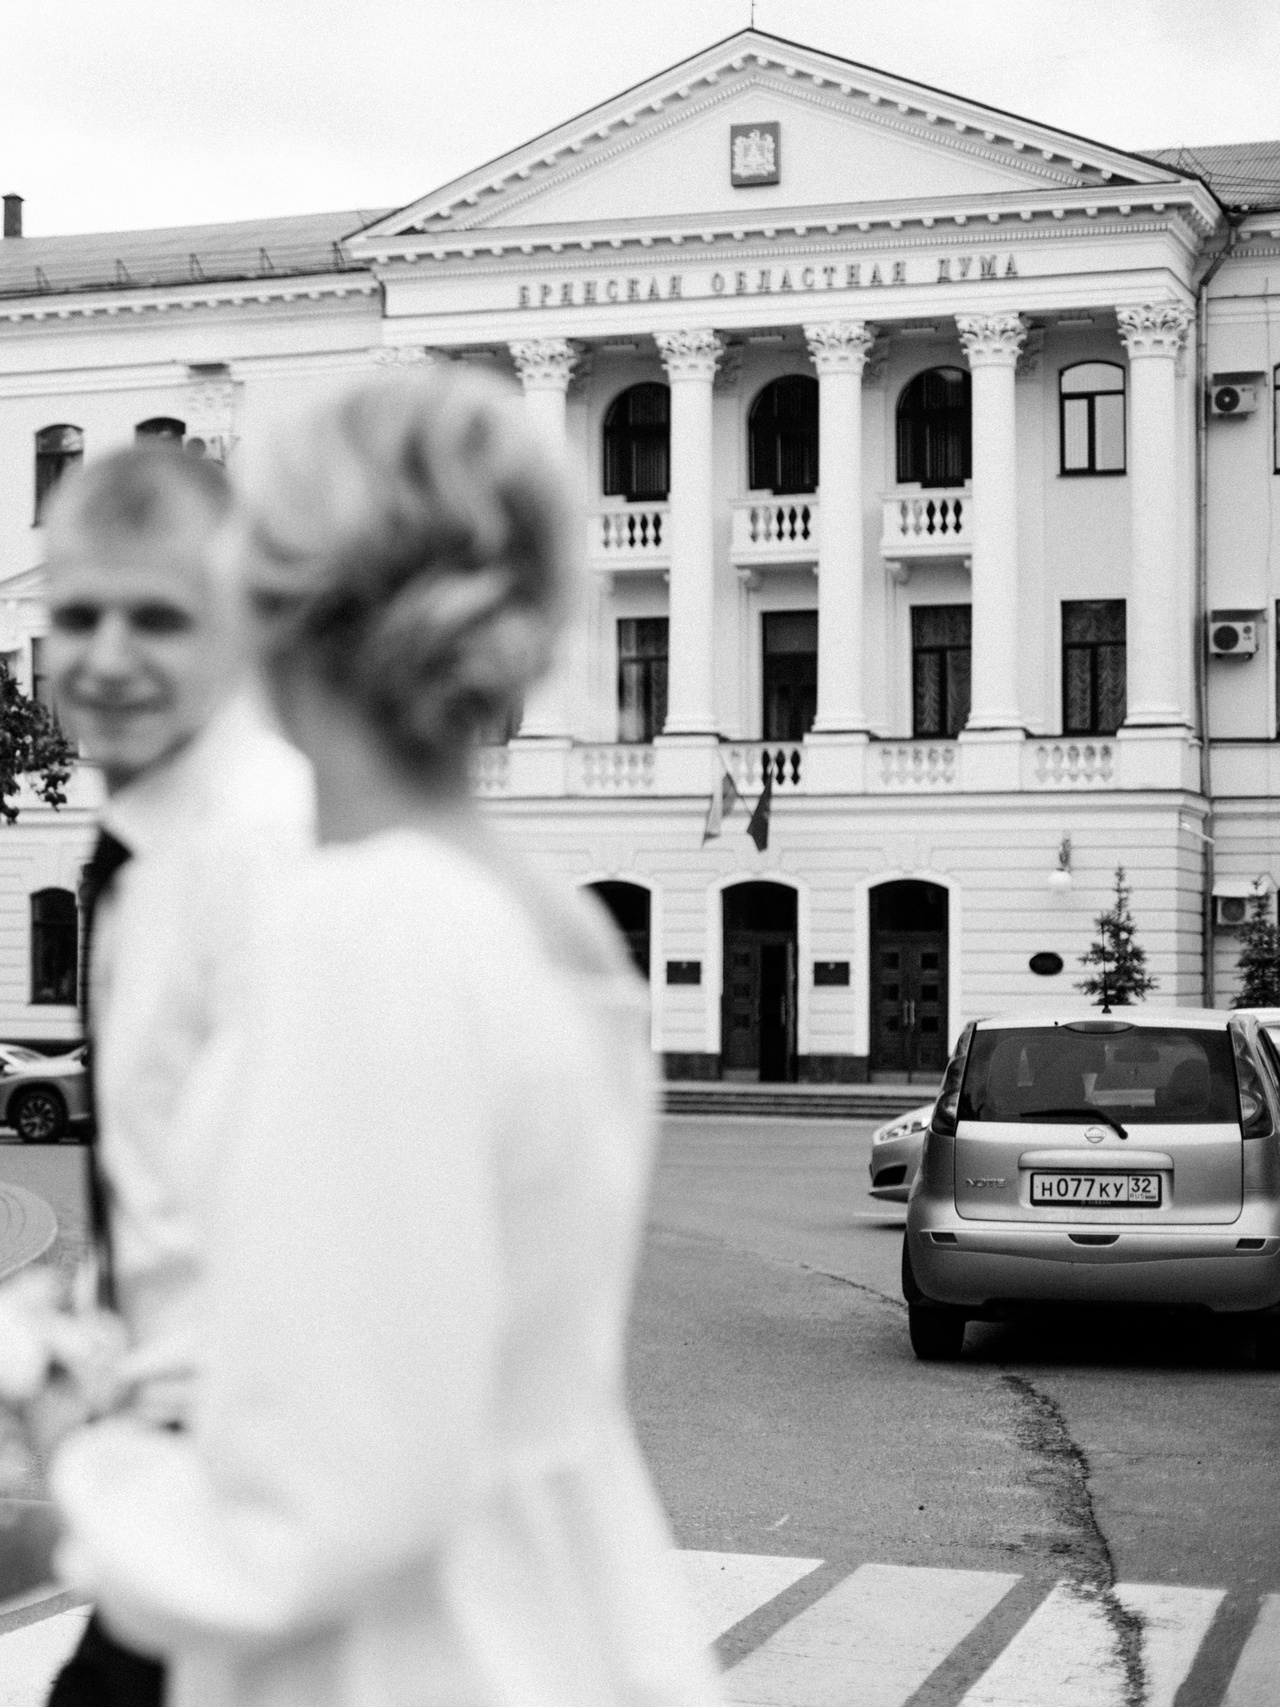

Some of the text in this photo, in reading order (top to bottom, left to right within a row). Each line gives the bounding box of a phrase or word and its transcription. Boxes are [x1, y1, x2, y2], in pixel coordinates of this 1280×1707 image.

[519, 254, 1017, 305] БРЯНСКАЯ ОБЛАСТНАЯ ДУМА
[966, 1178, 1006, 1188] NOTE
[1131, 1177, 1151, 1193] 32
